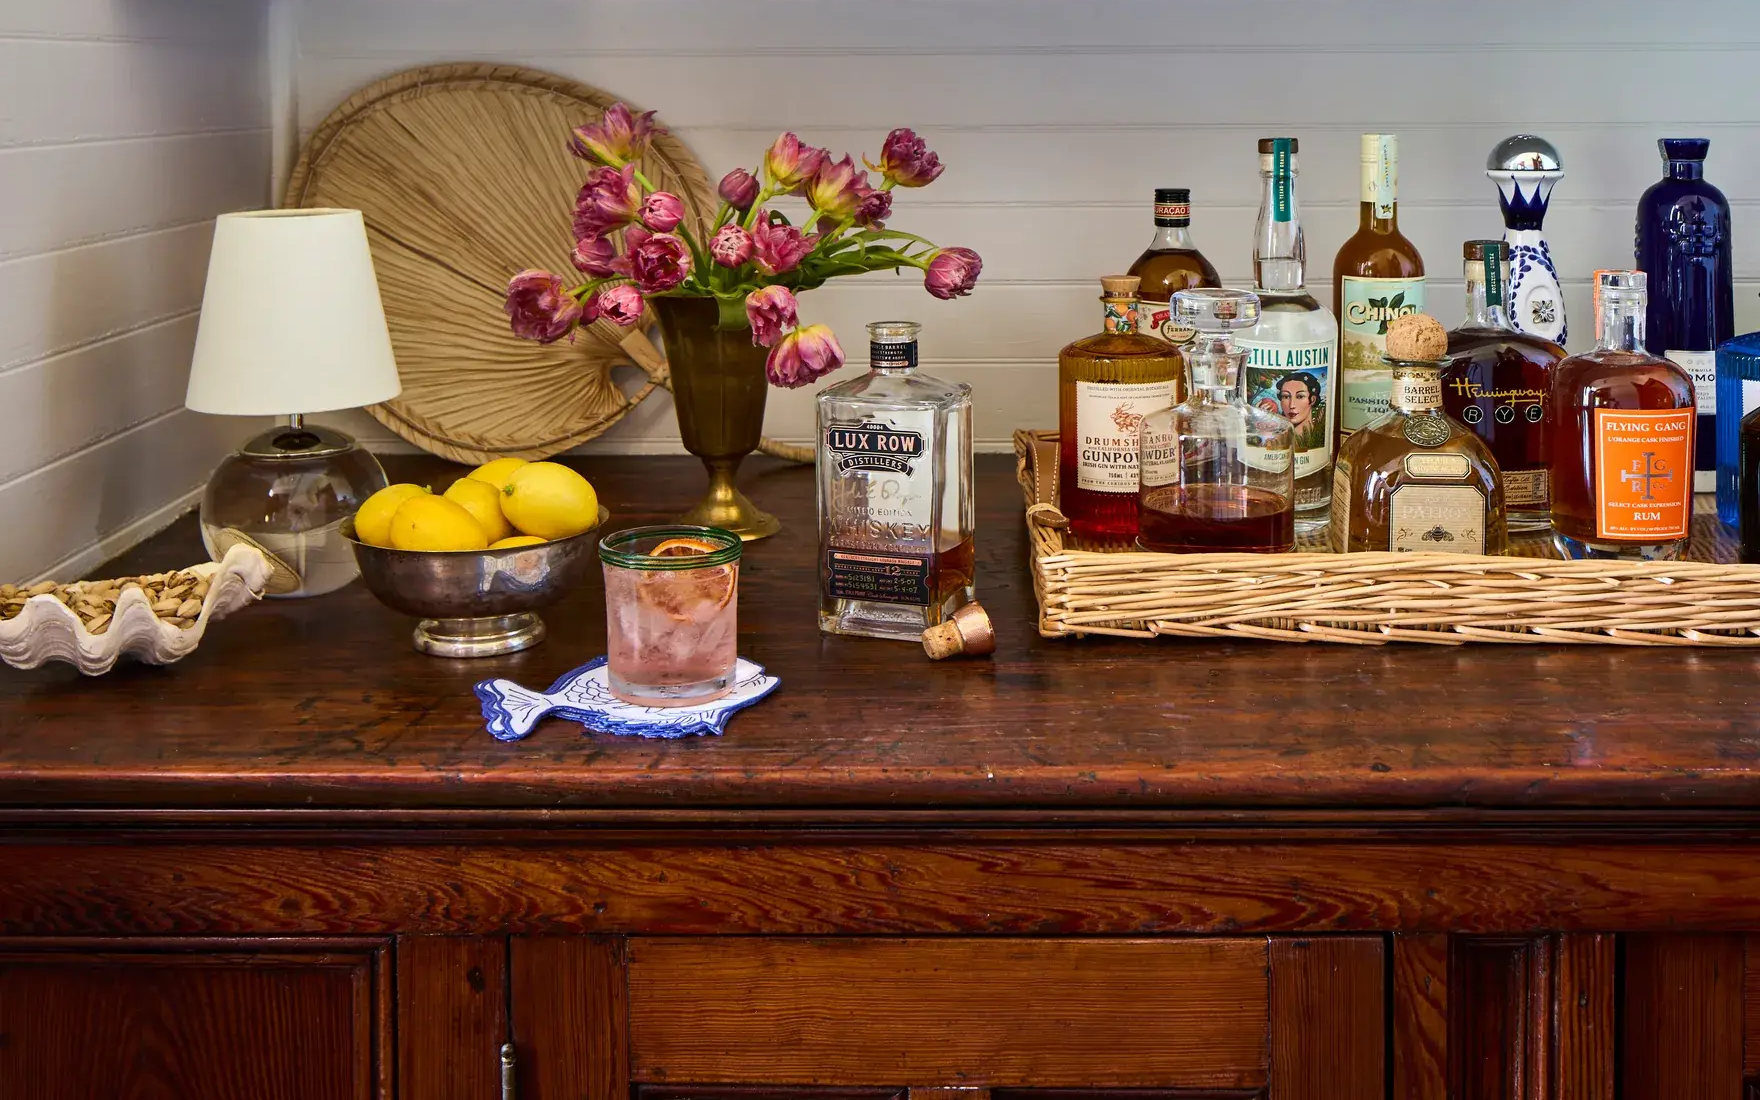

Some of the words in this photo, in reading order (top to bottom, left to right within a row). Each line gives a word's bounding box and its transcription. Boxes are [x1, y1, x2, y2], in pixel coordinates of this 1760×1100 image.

[1286, 346, 1329, 367] AUSTIN
[1404, 385, 1440, 395] BARREL
[1404, 395, 1440, 404] SELECT
[1606, 422, 1650, 432] FLYING
[1654, 421, 1686, 432] GANG
[835, 432, 870, 450] LUX
[877, 434, 915, 452] ROW
[848, 456, 903, 469] DISTILLERS
[1300, 455, 1310, 465] GIN
[1633, 511, 1661, 521] RUM
[829, 515, 931, 542] WHISKEY
[884, 565, 901, 576] 12
